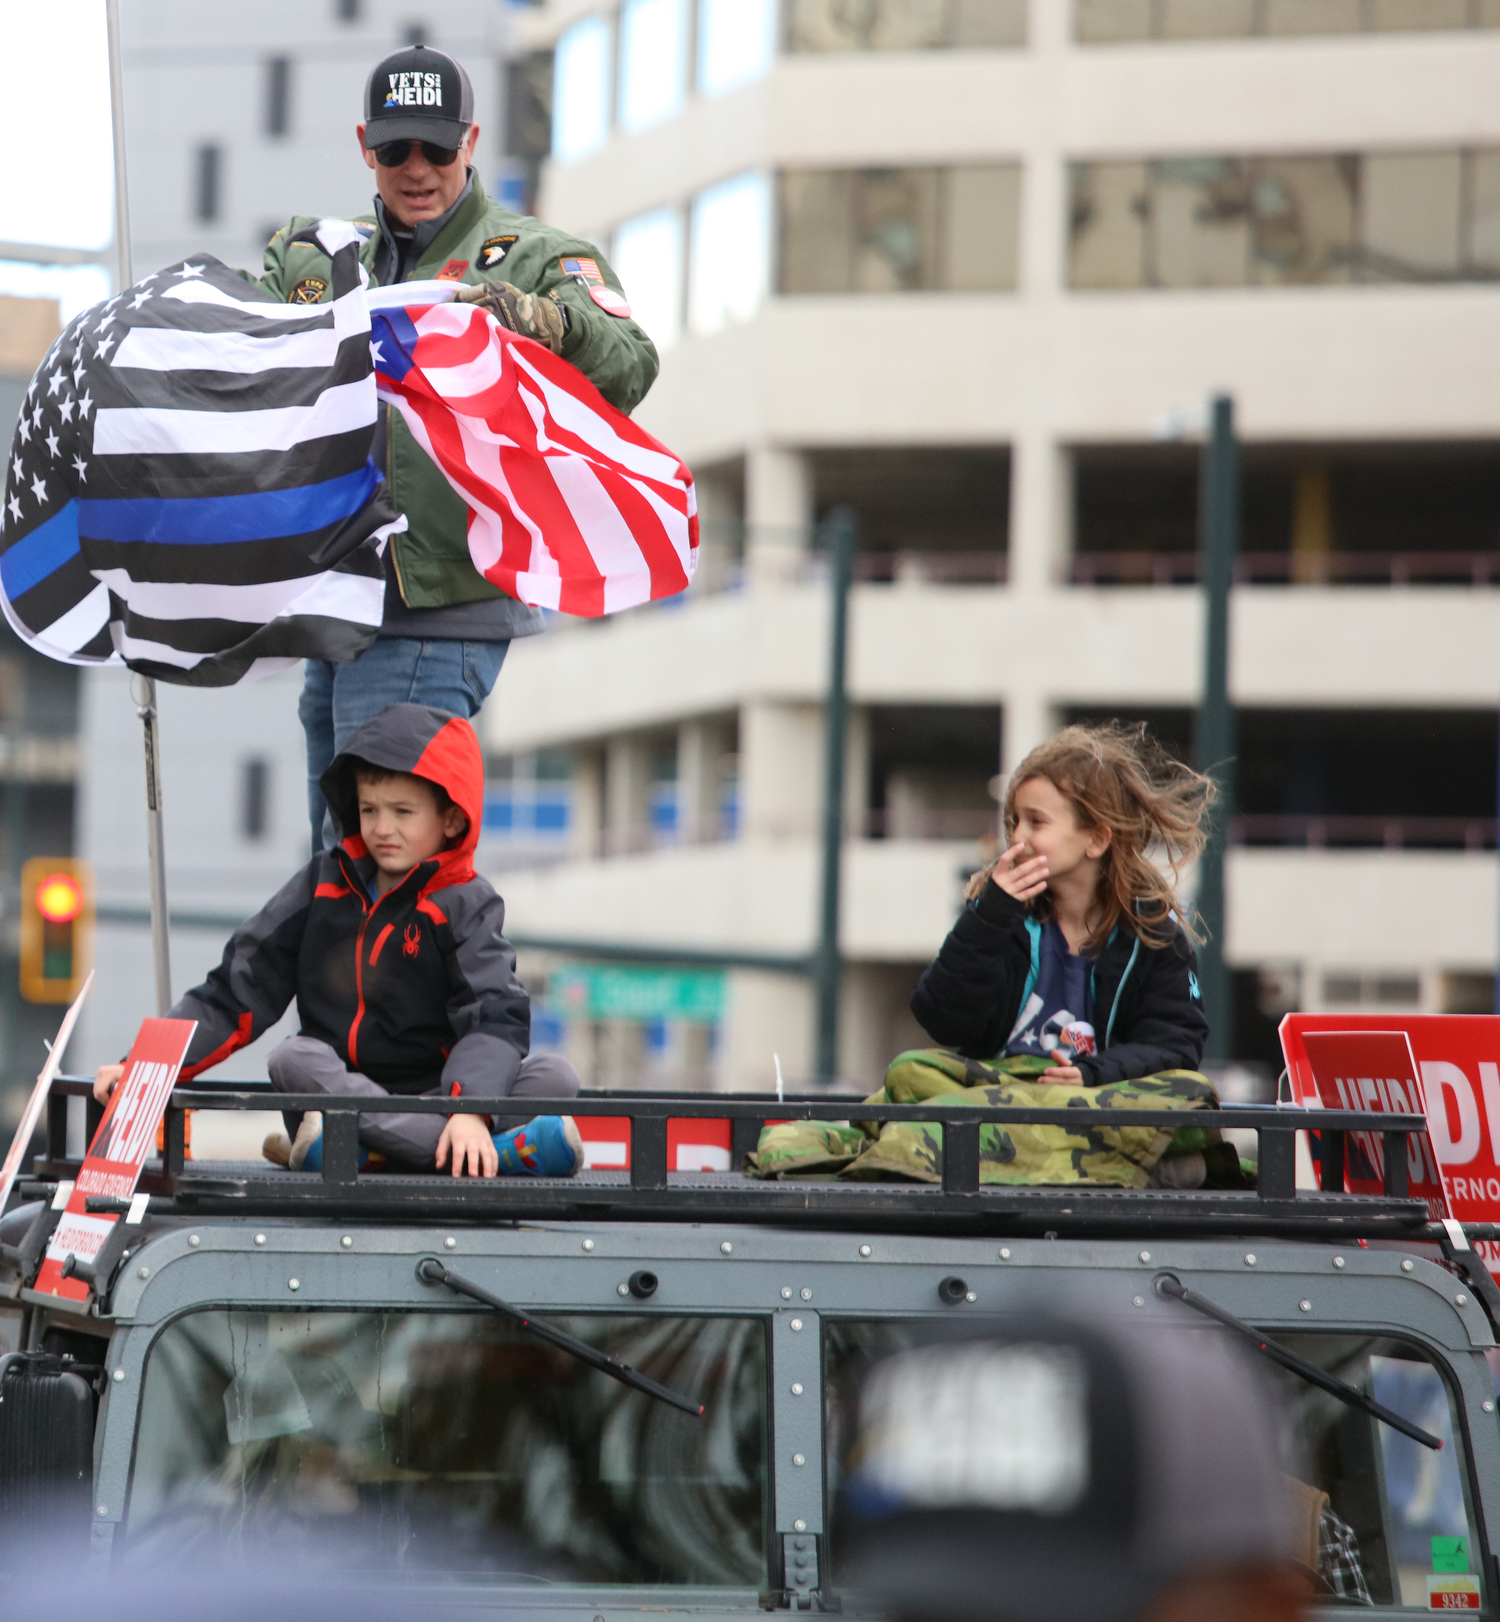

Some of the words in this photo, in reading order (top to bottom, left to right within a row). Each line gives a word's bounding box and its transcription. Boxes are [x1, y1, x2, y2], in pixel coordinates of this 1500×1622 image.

[388, 72, 435, 88] VETS
[391, 86, 443, 107] HEIDI
[104, 1060, 178, 1166] HEIDI
[1442, 1593, 1468, 1609] 9342
